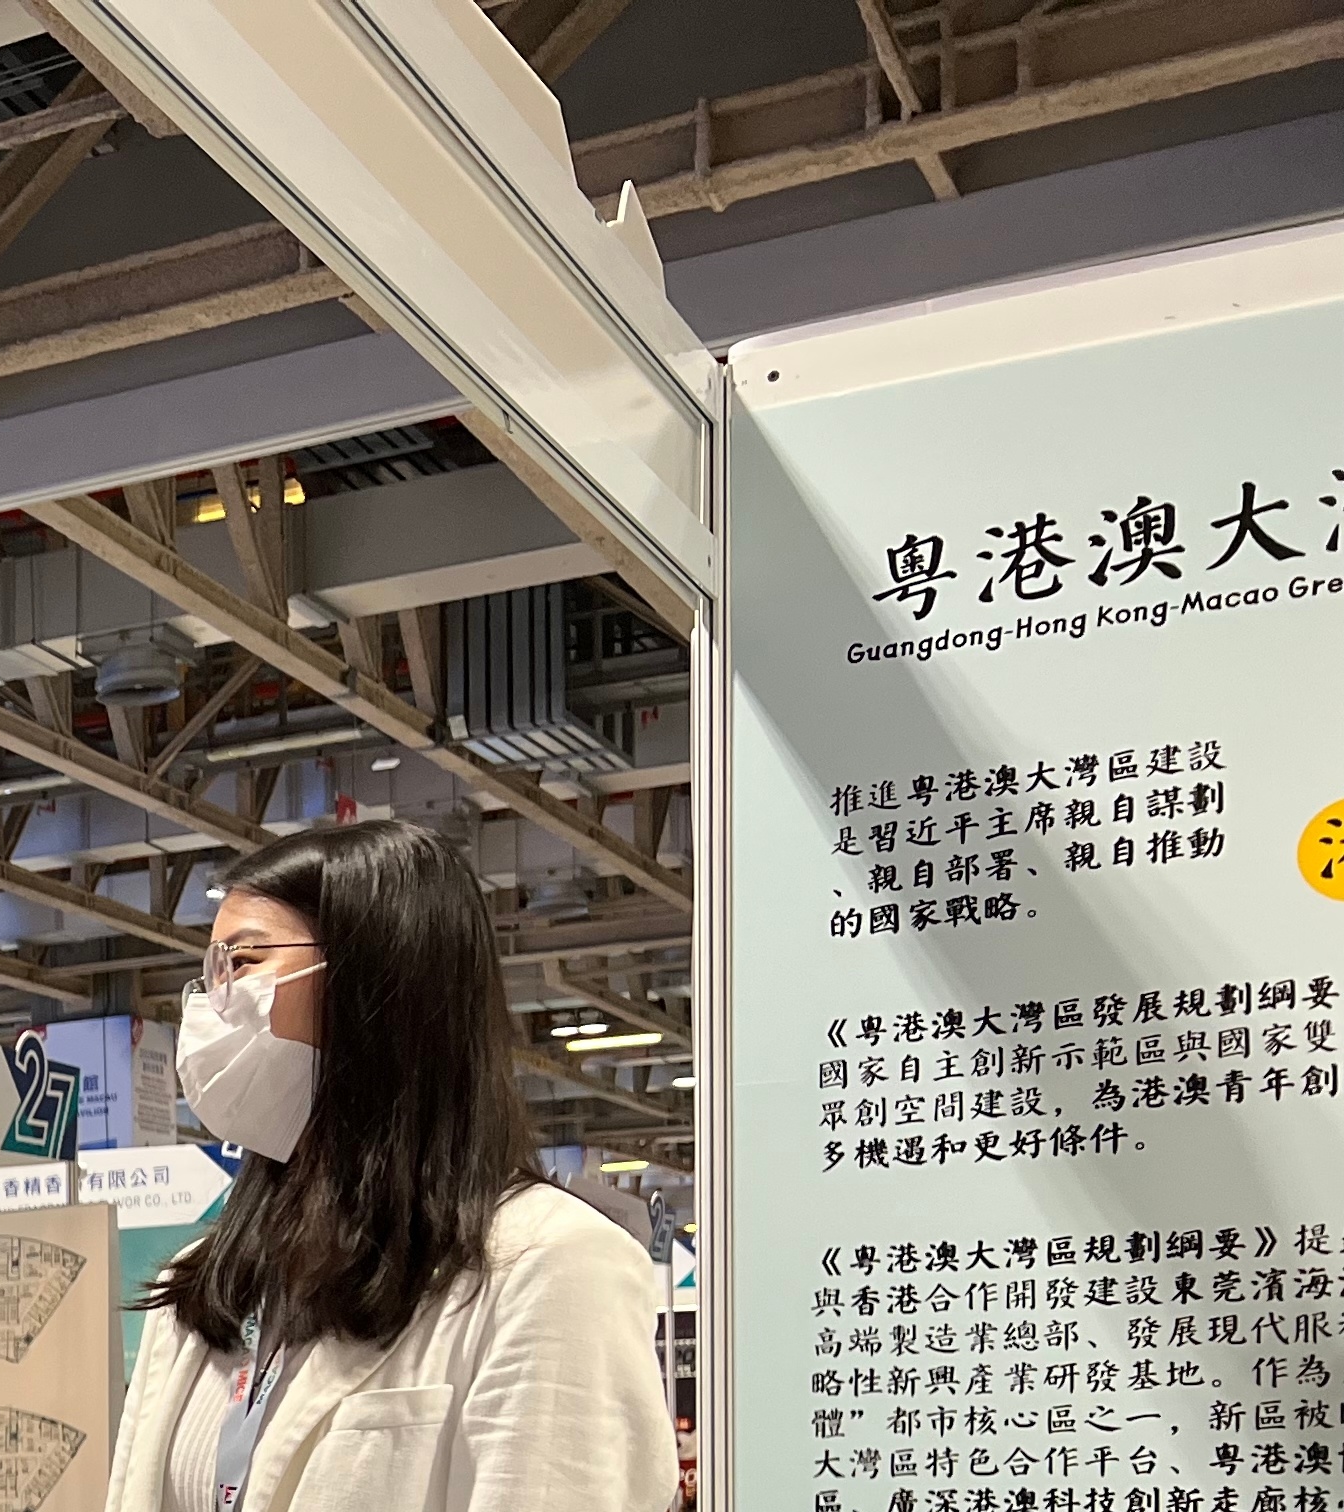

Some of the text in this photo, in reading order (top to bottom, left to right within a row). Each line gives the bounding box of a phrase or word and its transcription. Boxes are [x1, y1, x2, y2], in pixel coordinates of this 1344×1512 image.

[846, 612, 1087, 664] Guangdong-Hong
[1097, 583, 1279, 627] Kong-Macao
[830, 740, 1227, 817] 推進粵港澳大灣區建設
[831, 780, 1224, 856] 是習近平主席親自謀劃
[819, 1018, 1337, 1092] 國家自主創新示範區與國家雙
[821, 1223, 1344, 1277] 《粵港澳大灣區規劃綱要》提
[811, 1267, 1344, 1318] 與香港合作開發建設東莞濱海
[814, 1310, 1344, 1358] 高端製造業總部、發展現代服
[811, 1354, 1344, 1398] 略性新興產業研發基地。作為
[811, 1399, 1344, 1440] 體”都市核心區之一，新區被
[814, 1442, 1344, 1480] 大灣區特色合作平台、粵港澳
